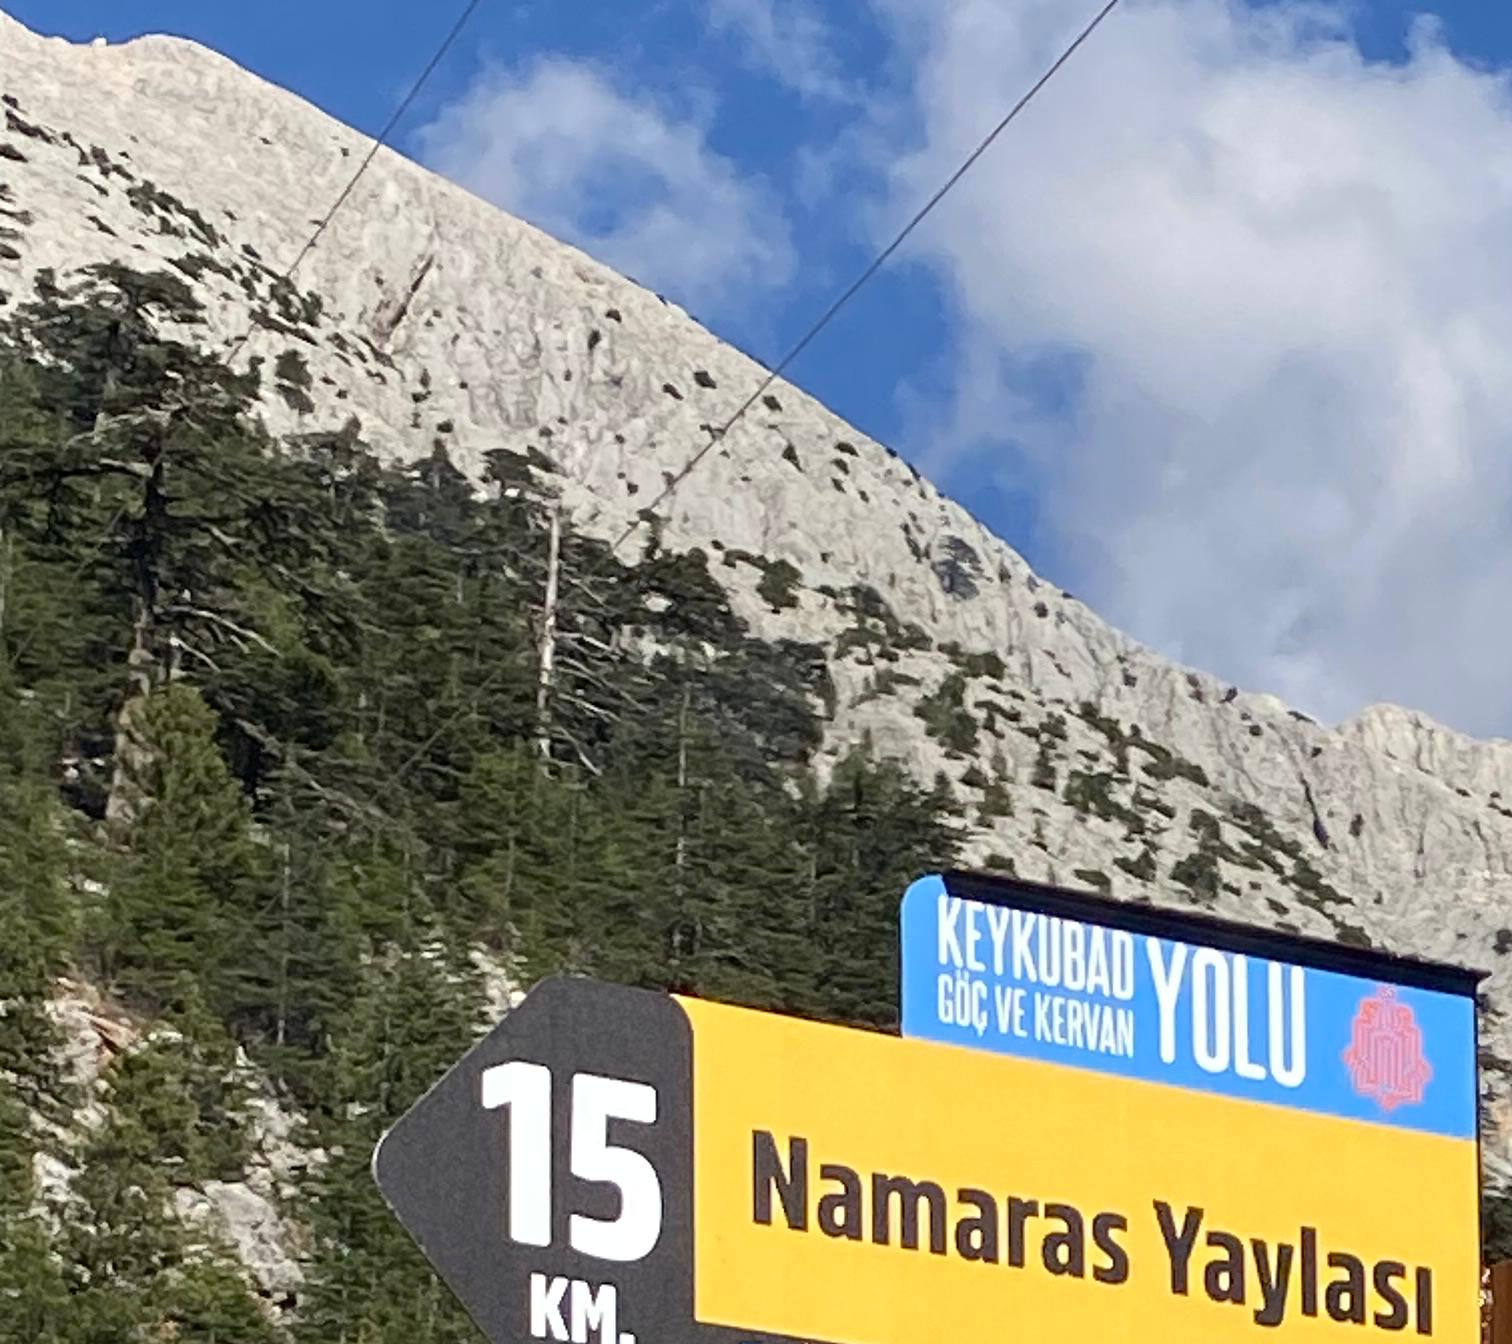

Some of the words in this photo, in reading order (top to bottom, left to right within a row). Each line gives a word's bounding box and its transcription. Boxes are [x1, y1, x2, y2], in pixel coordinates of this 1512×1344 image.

[937, 893, 1135, 1001] KEYKUBAD
[1147, 935, 1306, 1088] YOLU
[937, 968, 988, 1038] GÖÇ
[995, 986, 1027, 1038] VE
[1034, 996, 1135, 1058] KERVAN
[481, 1060, 663, 1263] 15
[752, 1129, 1130, 1285] Namaras
[1153, 1199, 1433, 1337] Yaylası
